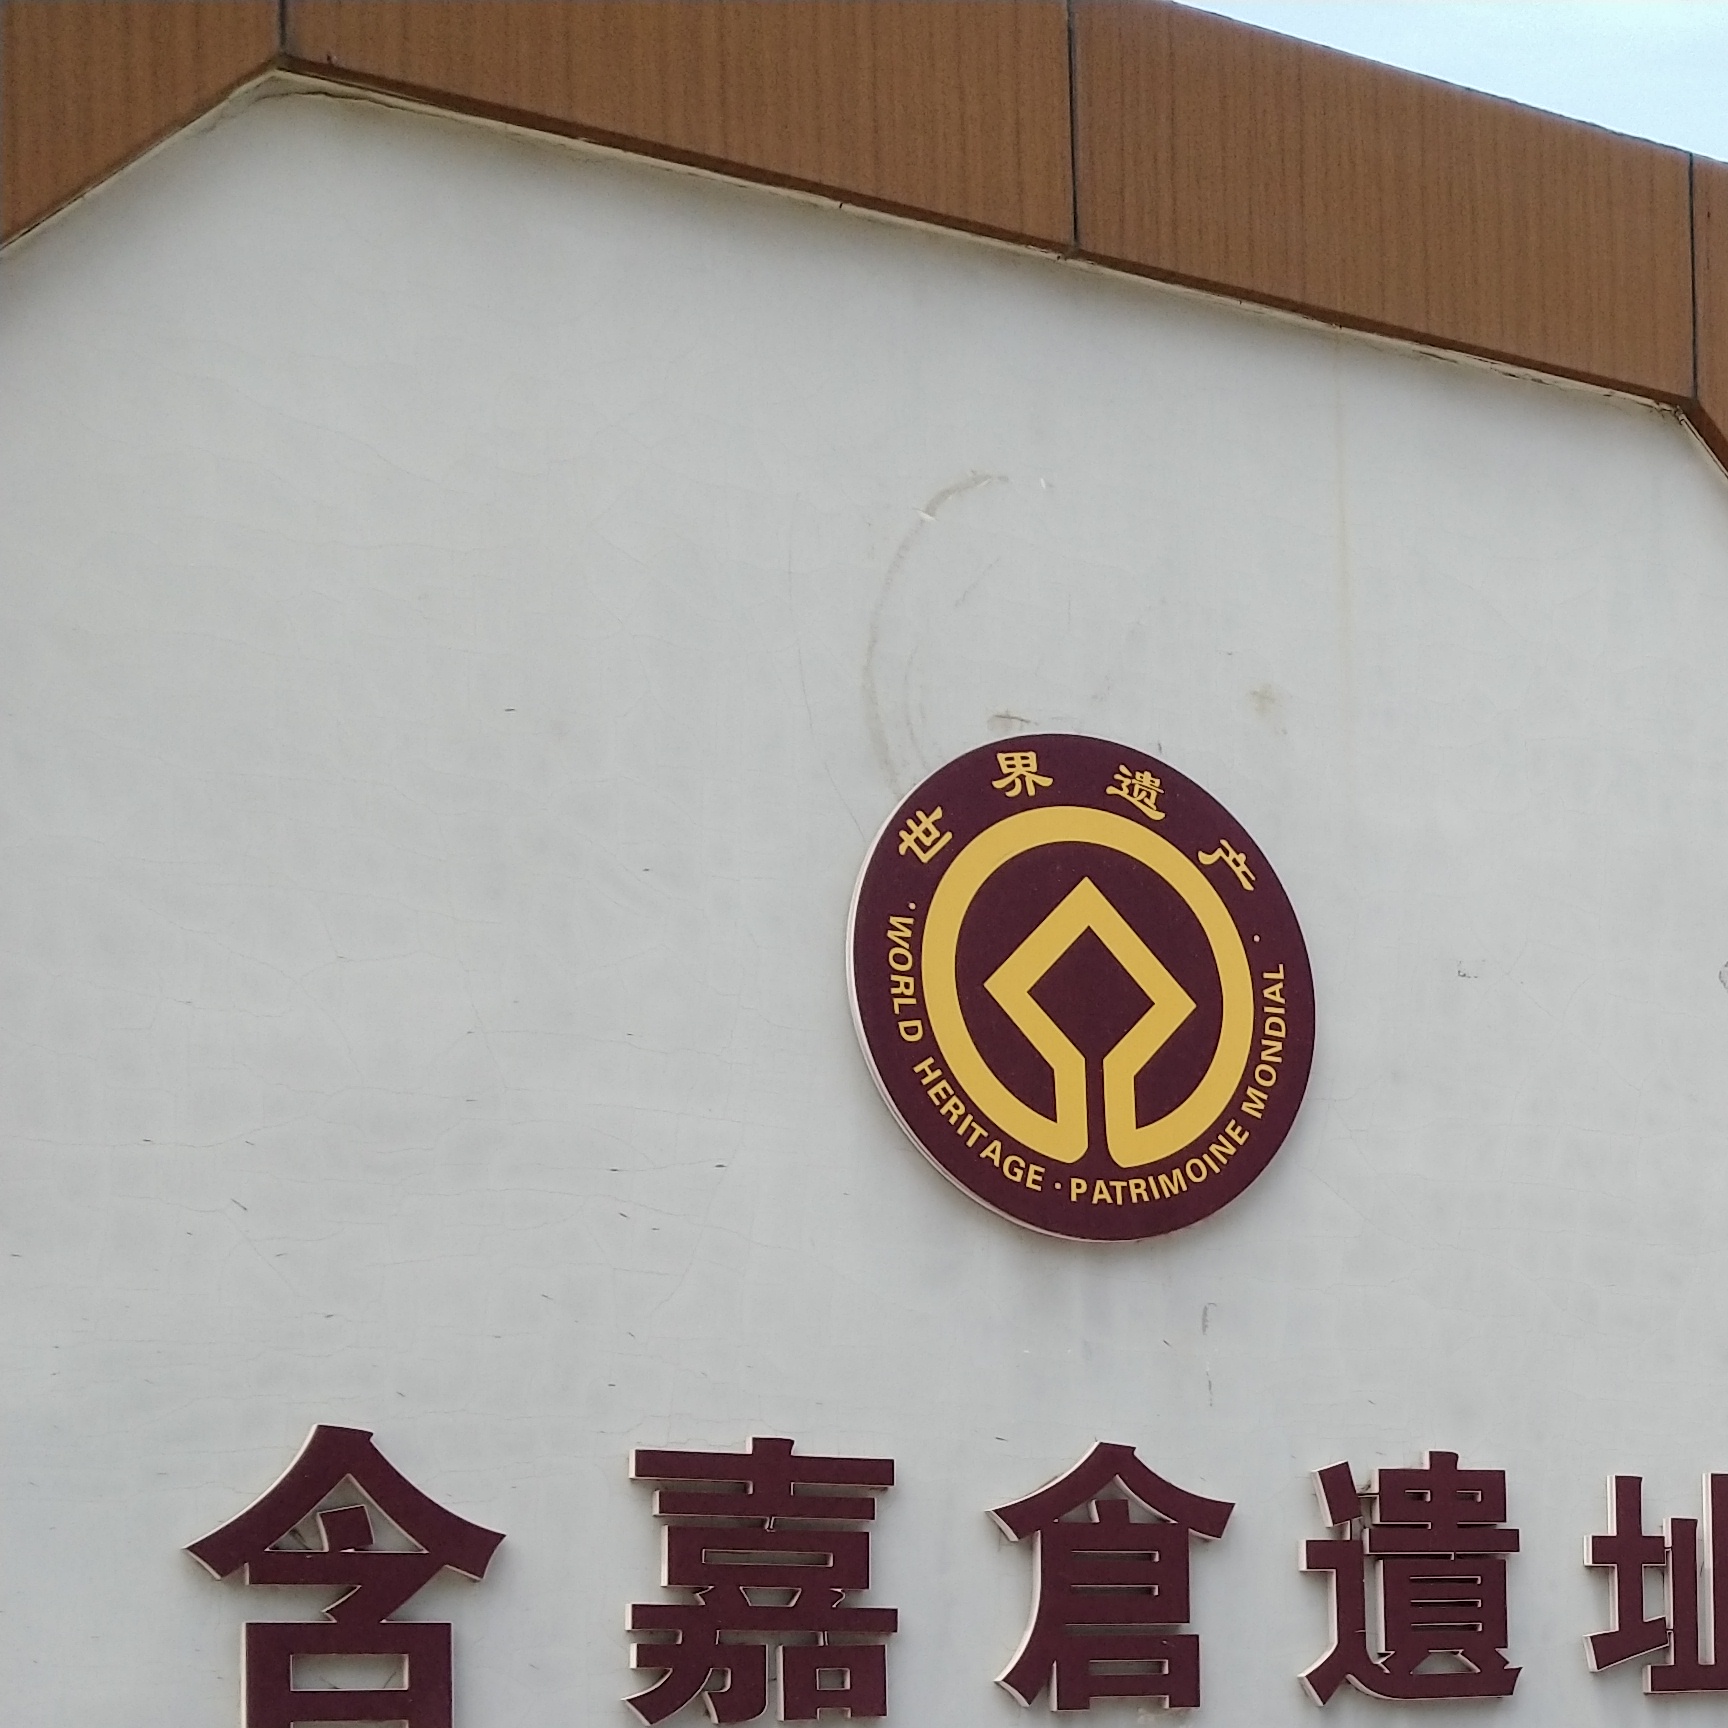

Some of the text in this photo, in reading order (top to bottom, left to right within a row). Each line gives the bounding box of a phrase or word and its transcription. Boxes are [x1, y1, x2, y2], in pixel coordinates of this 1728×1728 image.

[897, 751, 1257, 892] 世界遗产
[888, 914, 1287, 1207] WORLD HERITAGE PATRIMOINE MONDIAL
